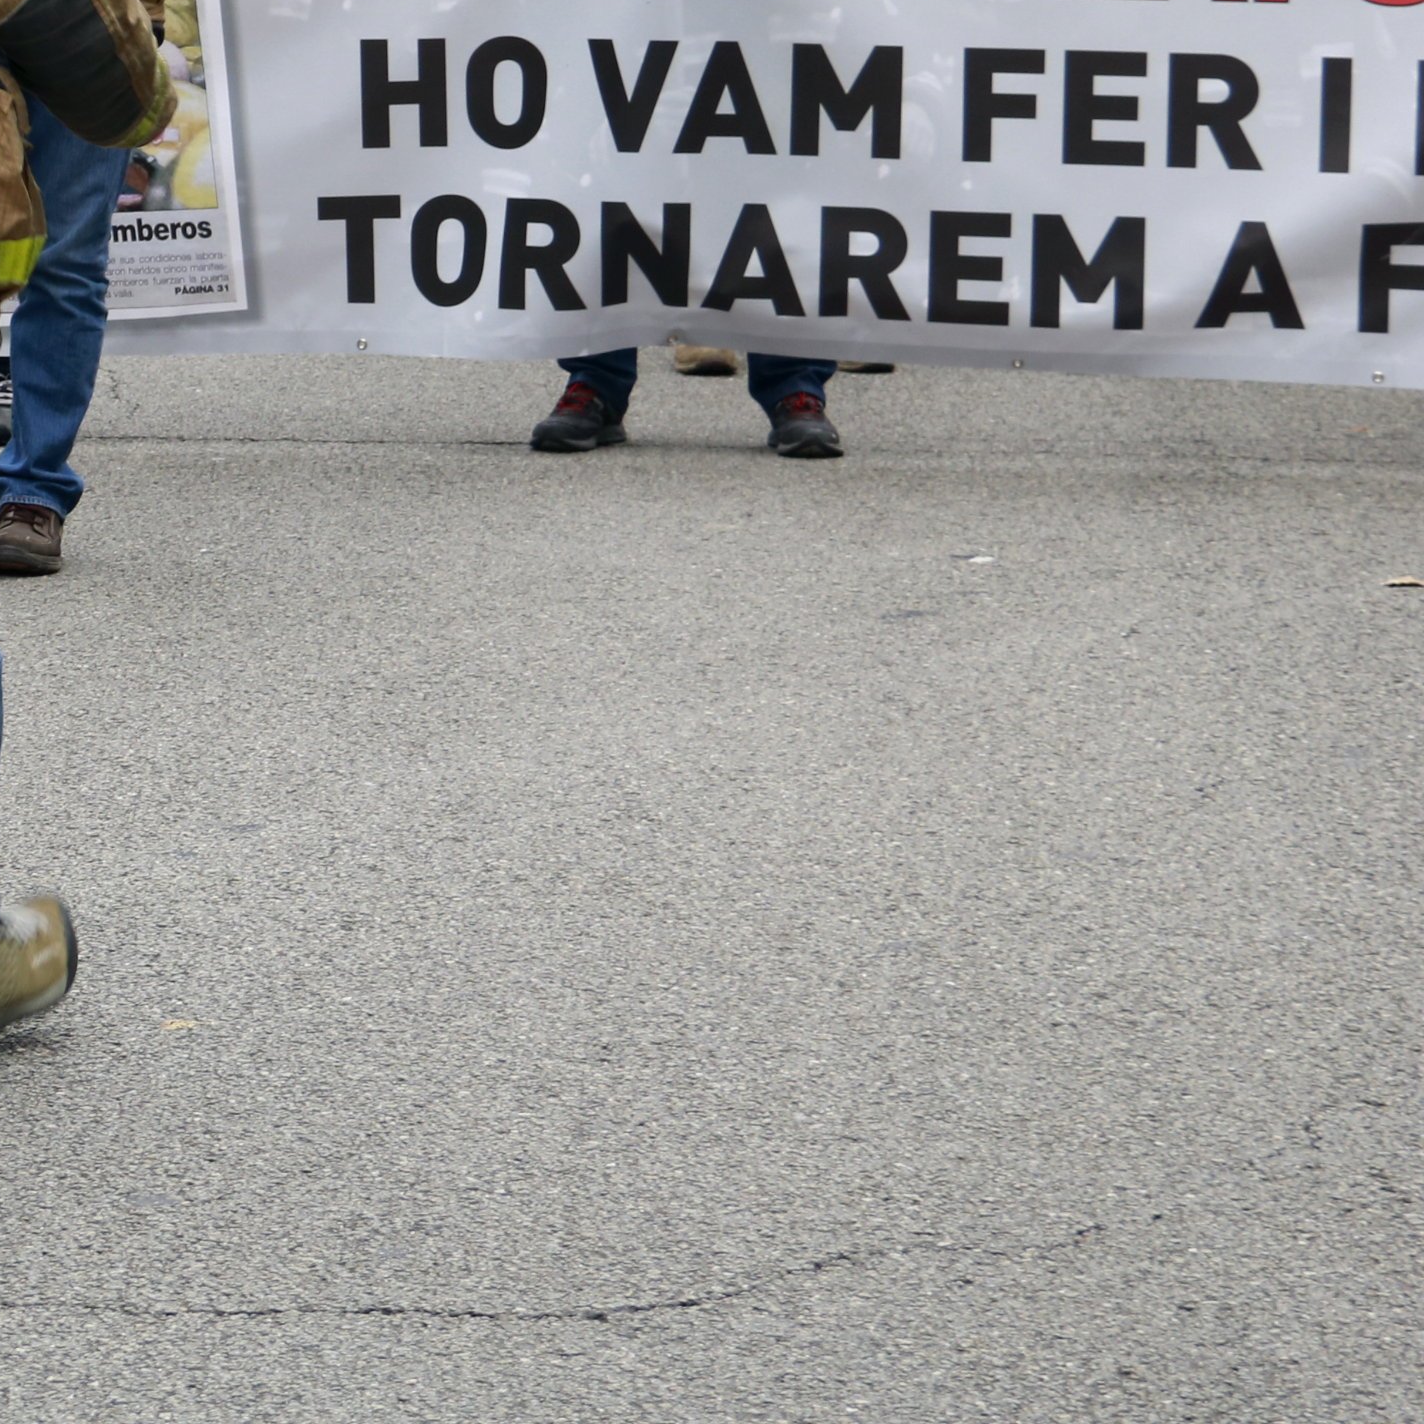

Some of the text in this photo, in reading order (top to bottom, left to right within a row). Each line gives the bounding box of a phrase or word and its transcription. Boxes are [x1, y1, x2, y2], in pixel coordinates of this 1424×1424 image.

[360, 36, 548, 150] HO
[588, 39, 903, 159] VAM
[962, 47, 1263, 170] FER
[1318, 57, 1353, 174] I
[108, 218, 213, 243] mberos
[318, 194, 1146, 330] TORNAREM
[1194, 220, 1305, 330] A
[216, 284, 230, 293] 31
